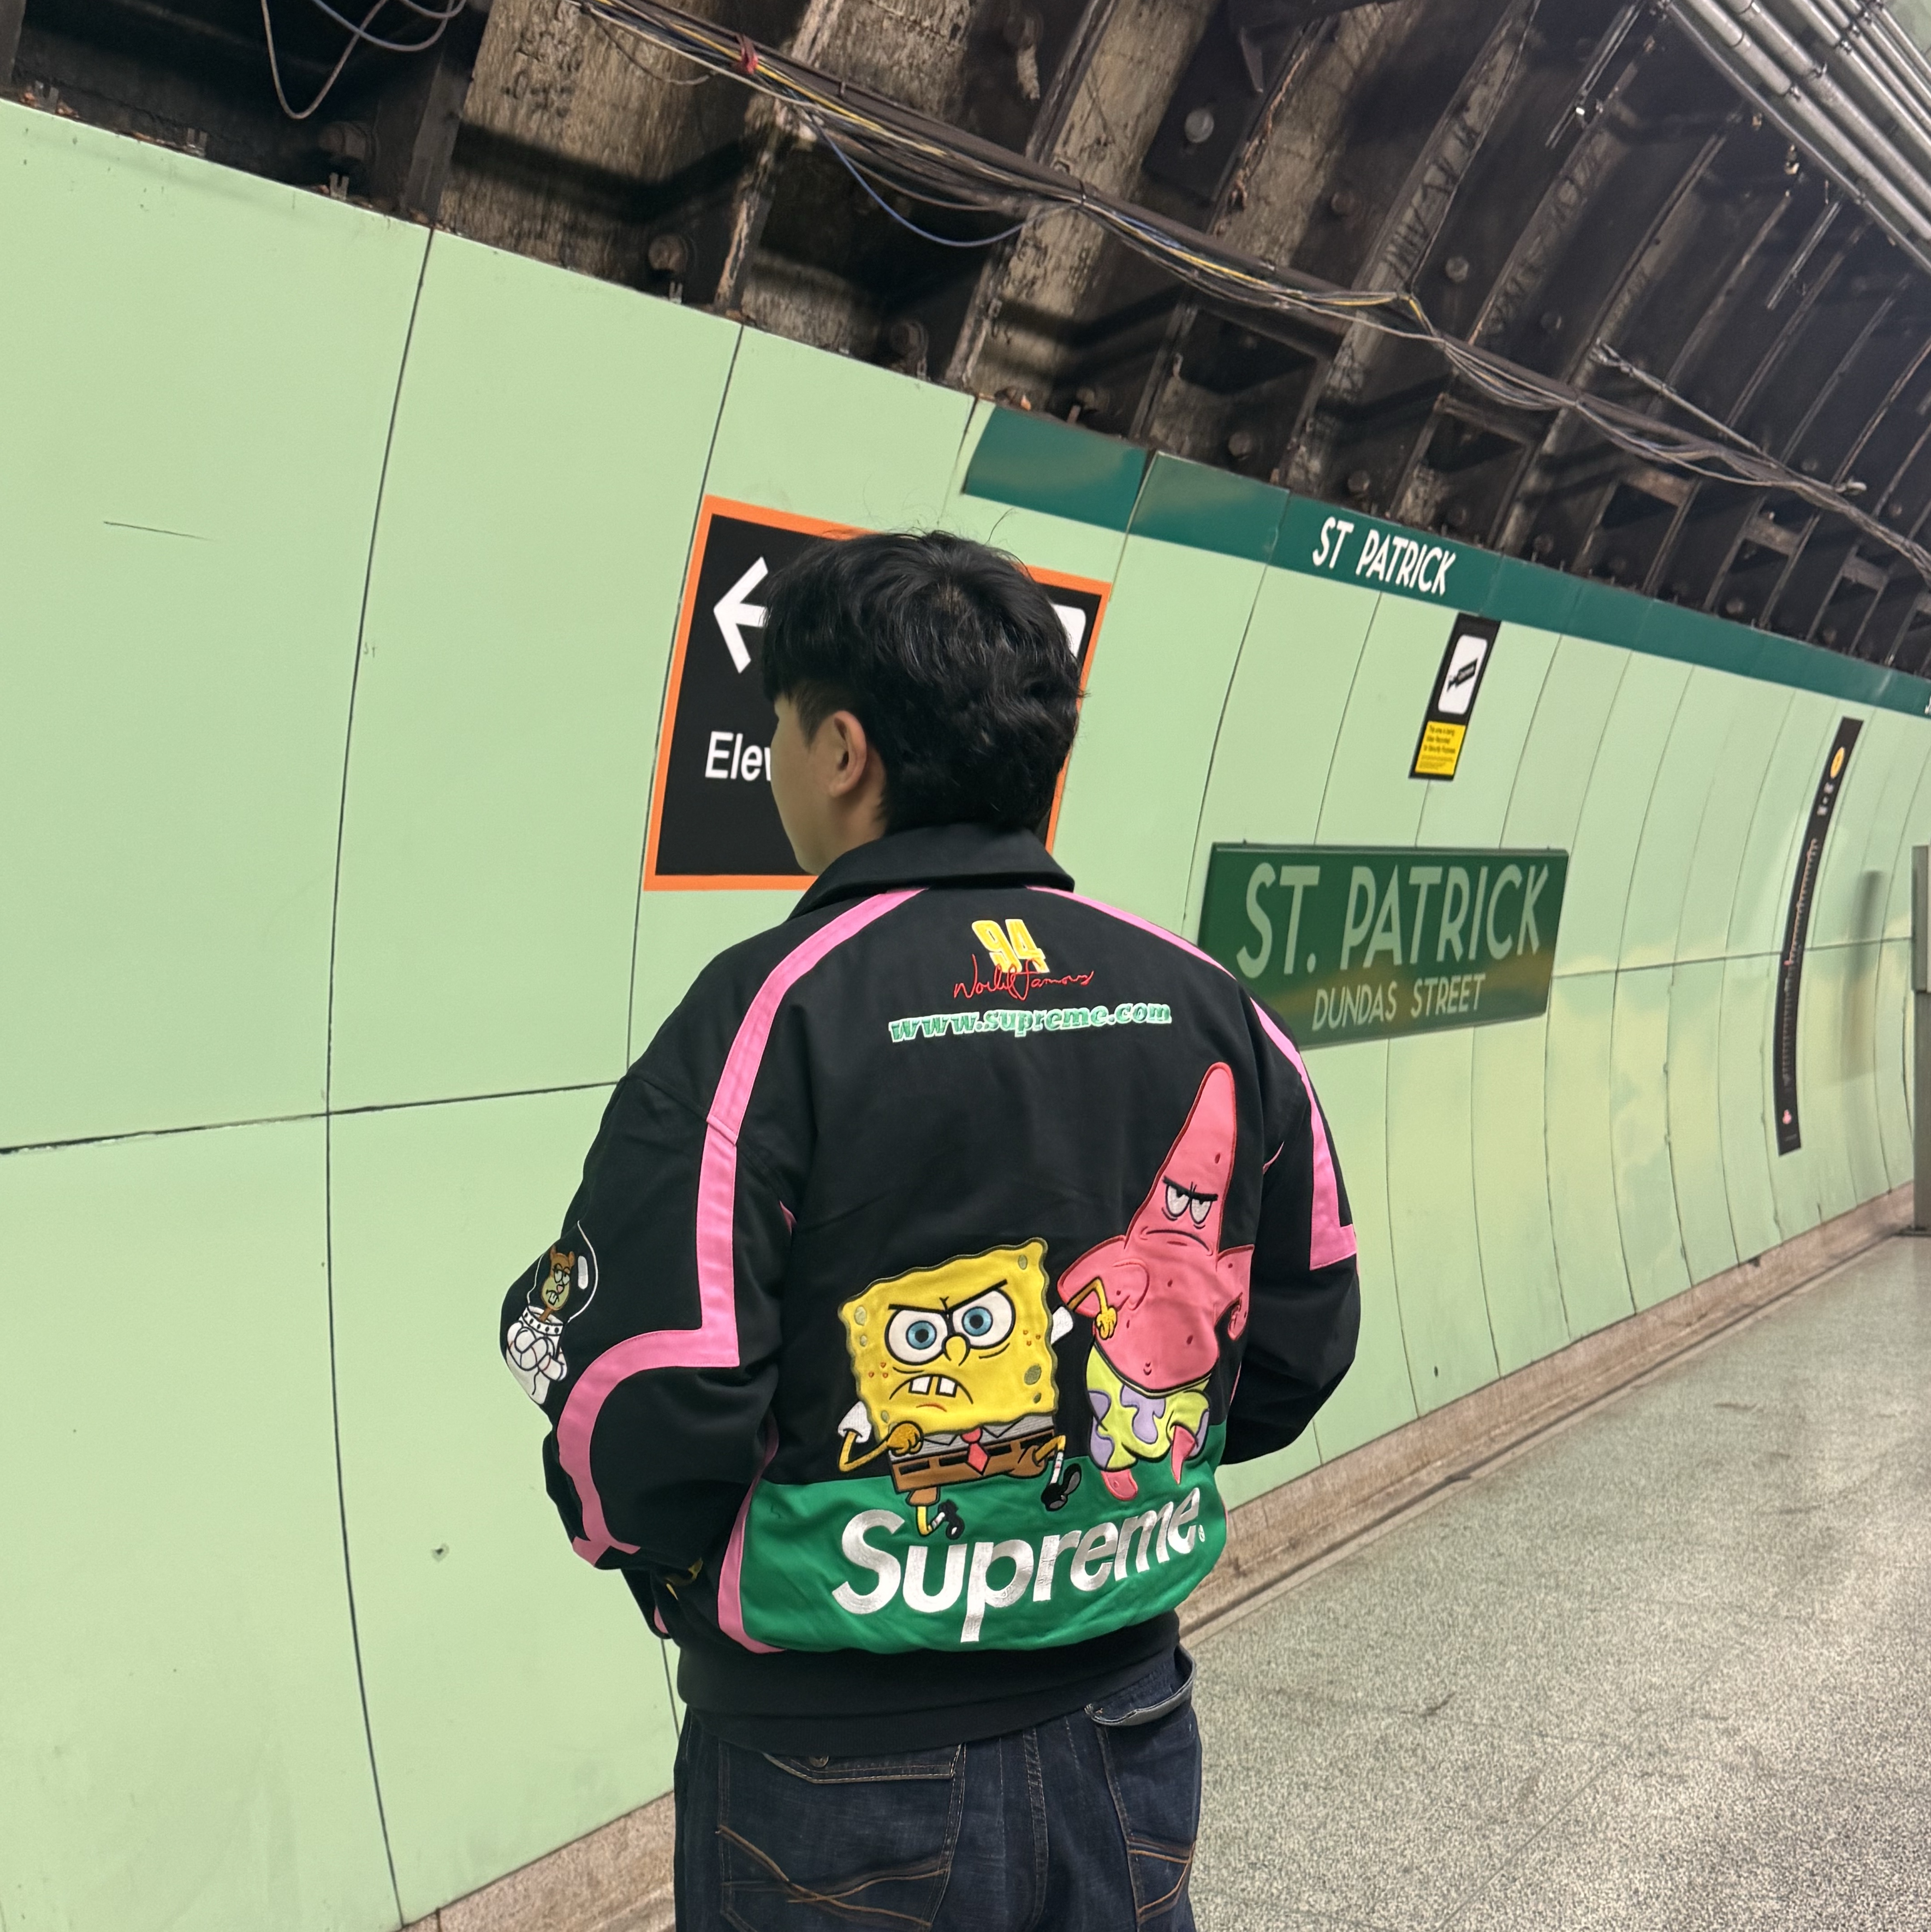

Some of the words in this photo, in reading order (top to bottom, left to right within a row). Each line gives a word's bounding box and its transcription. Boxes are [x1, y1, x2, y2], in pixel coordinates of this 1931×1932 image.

[1312, 516, 1354, 569] ST
[1355, 529, 1456, 596] PATRICK
[971, 918, 1050, 974] 94
[1236, 862, 1321, 979] ST.
[1340, 864, 1549, 971] PATRICK
[889, 1002, 1172, 1043] www.supreme.com
[1312, 981, 1398, 1031] DUNDAS
[1410, 973, 1486, 1018] STREET
